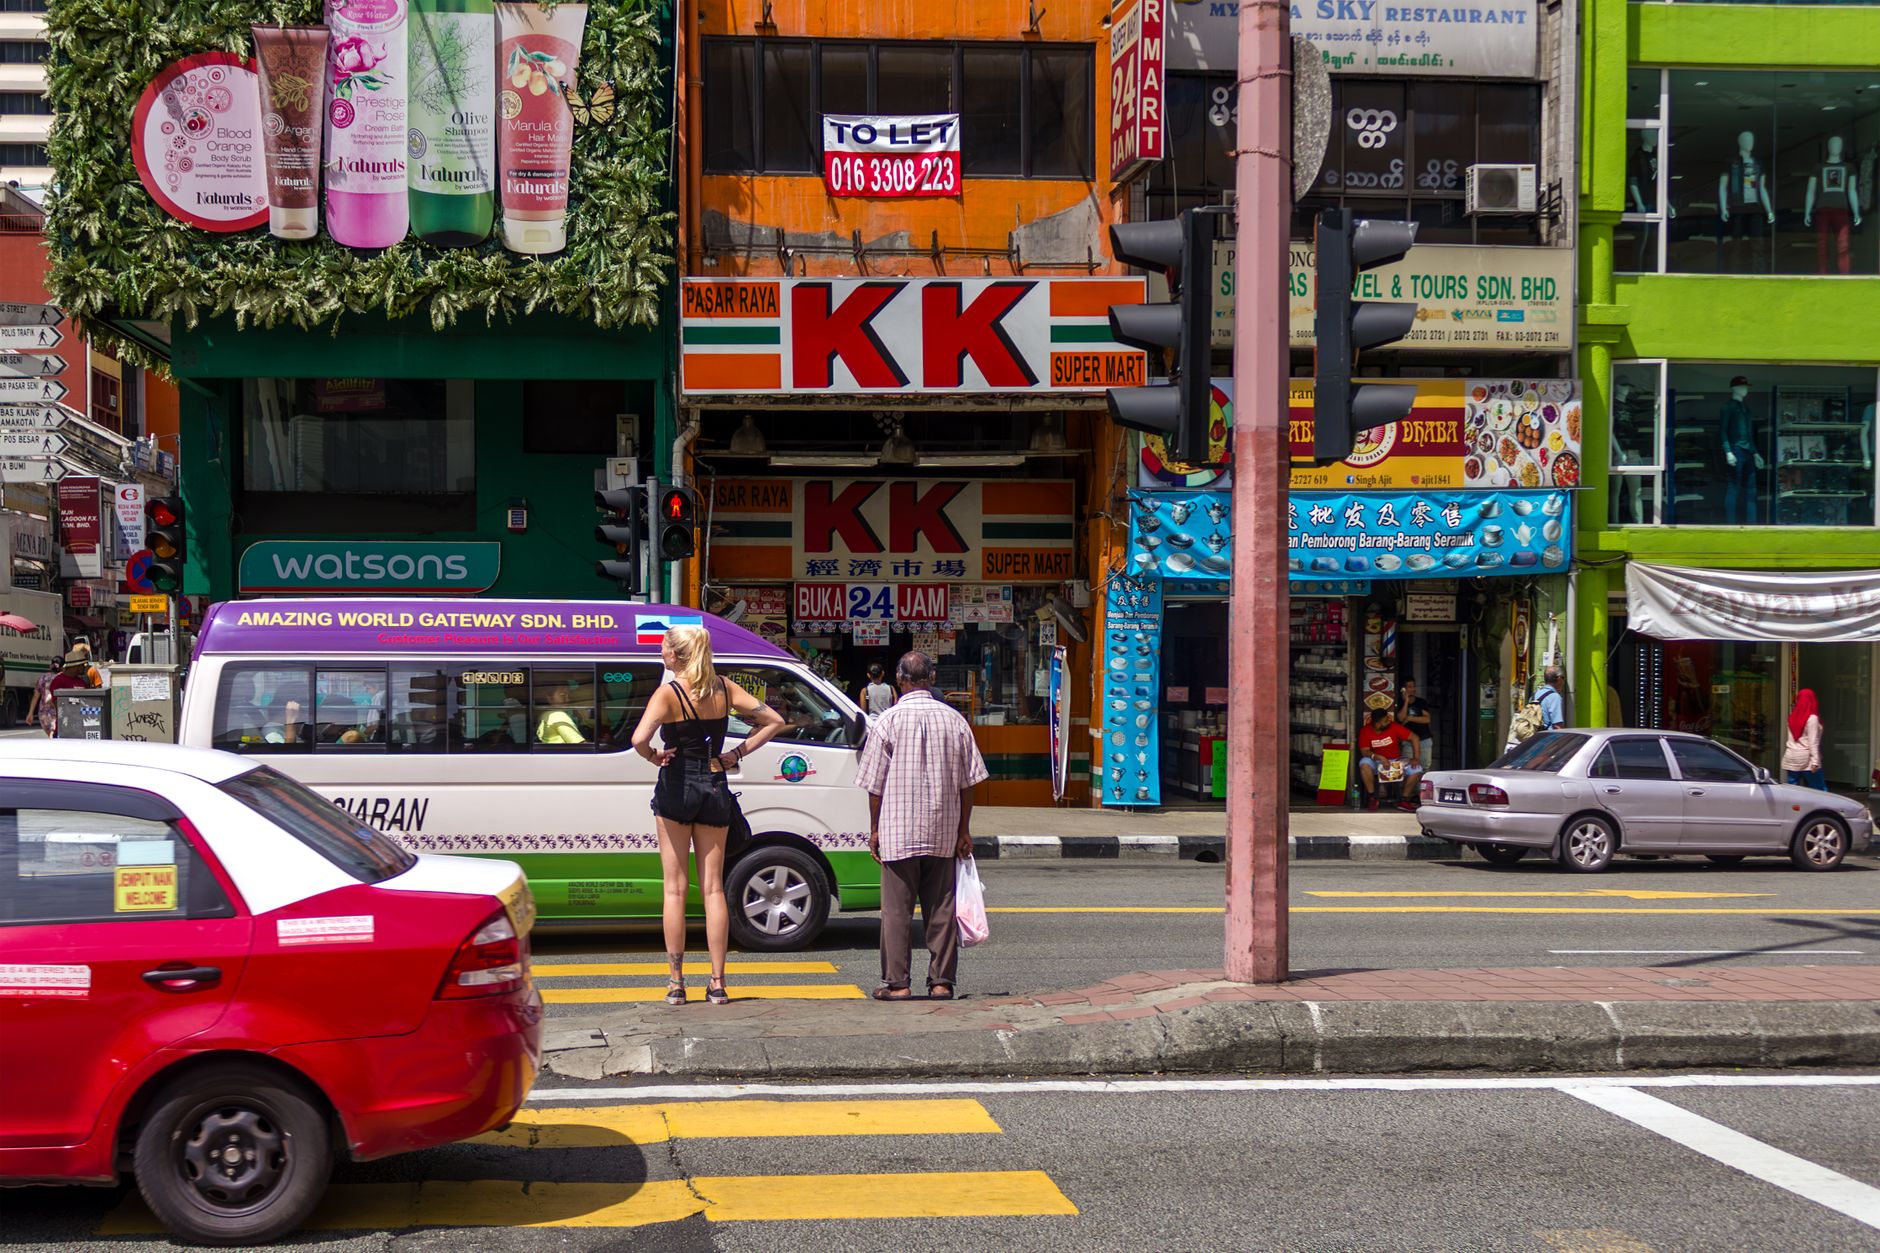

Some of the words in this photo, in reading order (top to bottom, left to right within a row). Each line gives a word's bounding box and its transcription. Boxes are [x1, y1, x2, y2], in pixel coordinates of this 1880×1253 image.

[1316, 0, 1376, 20] SKY
[1385, 8, 1527, 24] RESTAURANT
[1112, 52, 1136, 135] 24
[1142, 37, 1161, 150] MART
[356, 96, 406, 109] Prestige
[375, 110, 405, 121] Rose
[451, 111, 488, 125] Olive
[285, 126, 314, 136] Argan
[365, 124, 389, 132] Cream
[445, 127, 488, 137] Shampoo
[508, 120, 553, 131] Marula
[217, 128, 252, 139] Blood
[528, 133, 546, 142] Hair
[830, 122, 878, 145] TO
[889, 121, 954, 145] LET
[206, 141, 253, 154] Orange
[1112, 125, 1135, 171] JAM
[211, 155, 229, 163] Body
[231, 154, 252, 162] Scrub
[338, 156, 406, 174] Naturals
[372, 174, 381, 182] by
[420, 164, 488, 183] Naturals
[831, 156, 865, 191] 016
[870, 157, 915, 192] 3308
[921, 156, 955, 191] 223
[275, 176, 313, 187] Naturals
[454, 183, 462, 191] by
[507, 179, 567, 195] Naturals
[196, 192, 252, 205] Naturals
[1391, 274, 1402, 298] &
[1410, 275, 1468, 300] TOURS
[1477, 275, 1516, 301] SDN.
[1521, 278, 1560, 301] BHD.
[686, 288, 734, 313] PASAR
[739, 287, 777, 314] RAYA
[7, 305, 27, 314] STREET
[2, 328, 16, 337] POLIS
[18, 328, 35, 337] TRAFIK
[791, 281, 1040, 388] KK
[1454, 330, 1470, 340] 2072
[1473, 330, 1489, 341] 2731
[1496, 331, 1513, 342] FAX:
[11, 356, 23, 365] SENI
[1054, 355, 1101, 383] SUPER
[1106, 354, 1146, 383] MART
[1, 409, 14, 417] BAS
[16, 409, 40, 417] KLANG
[4, 436, 16, 444] POS
[18, 436, 40, 444] BESAR
[9, 463, 26, 471] BUMI
[1314, 475, 1328, 485] 619
[1356, 475, 1376, 488] Singh
[1378, 475, 1393, 488] Ajit
[1421, 475, 1451, 487] ajit1841
[751, 486, 789, 508] RAYA
[804, 480, 971, 554] KK
[1301, 532, 1357, 552] Pemborong
[1359, 532, 1431, 552] Barang-Barang
[1434, 532, 1474, 548] Seramik
[272, 551, 468, 580] watsons
[805, 558, 967, 578] 經濟市場
[986, 552, 1030, 574] SUPER
[1034, 552, 1071, 574] MART
[800, 586, 844, 618] BUKA
[849, 586, 895, 619] 24
[901, 587, 945, 618] JAM
[237, 612, 333, 627] AMAZING
[337, 612, 414, 628] WORLD
[418, 613, 516, 628] GATEWAY
[520, 613, 567, 629] SDN.
[572, 614, 619, 629] BHD.
[377, 634, 441, 645] Customer
[444, 634, 500, 645] Pleasure
